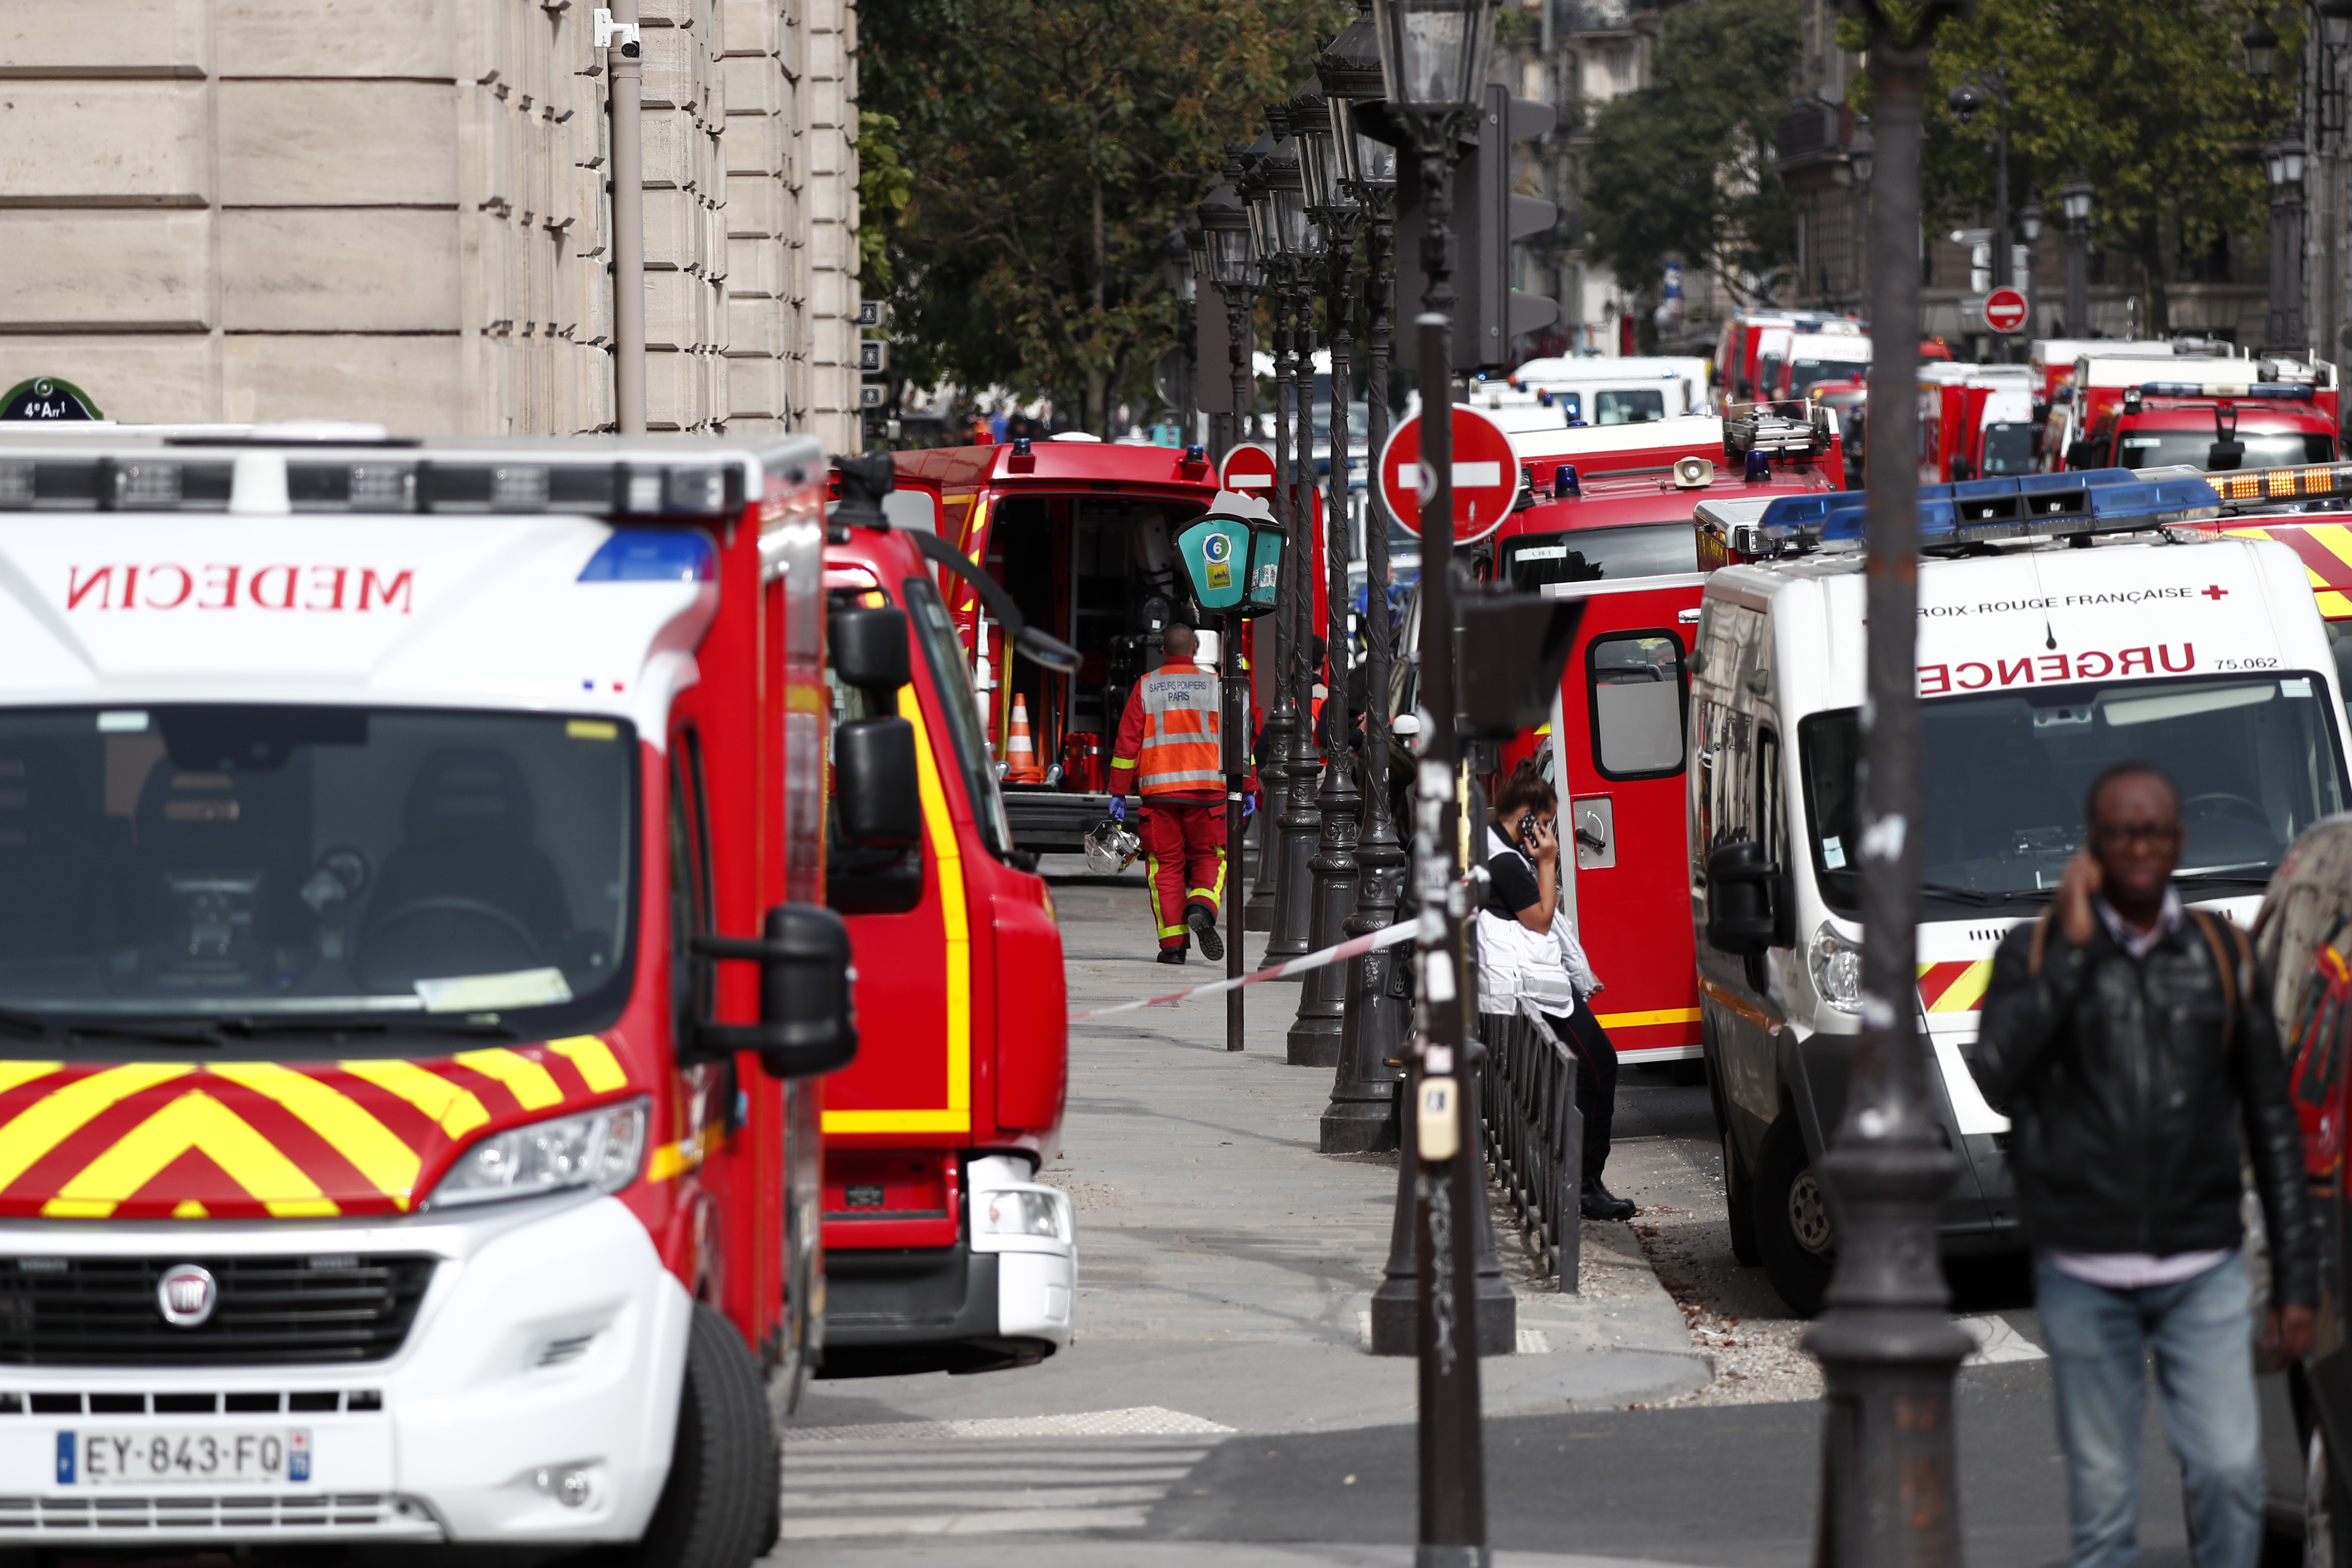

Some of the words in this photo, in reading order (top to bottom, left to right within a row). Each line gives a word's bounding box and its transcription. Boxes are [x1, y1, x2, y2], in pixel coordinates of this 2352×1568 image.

[1213, 542, 1222, 554] 6
[1916, 596, 2058, 618] ROIX-ROUGE
[2066, 587, 2193, 606] FRANÇAISE
[2214, 657, 2278, 670] 75.062
[1149, 681, 1176, 692] SAPEURS
[1177, 681, 1207, 690] POMPIERS
[1168, 691, 1190, 701] PARIS
